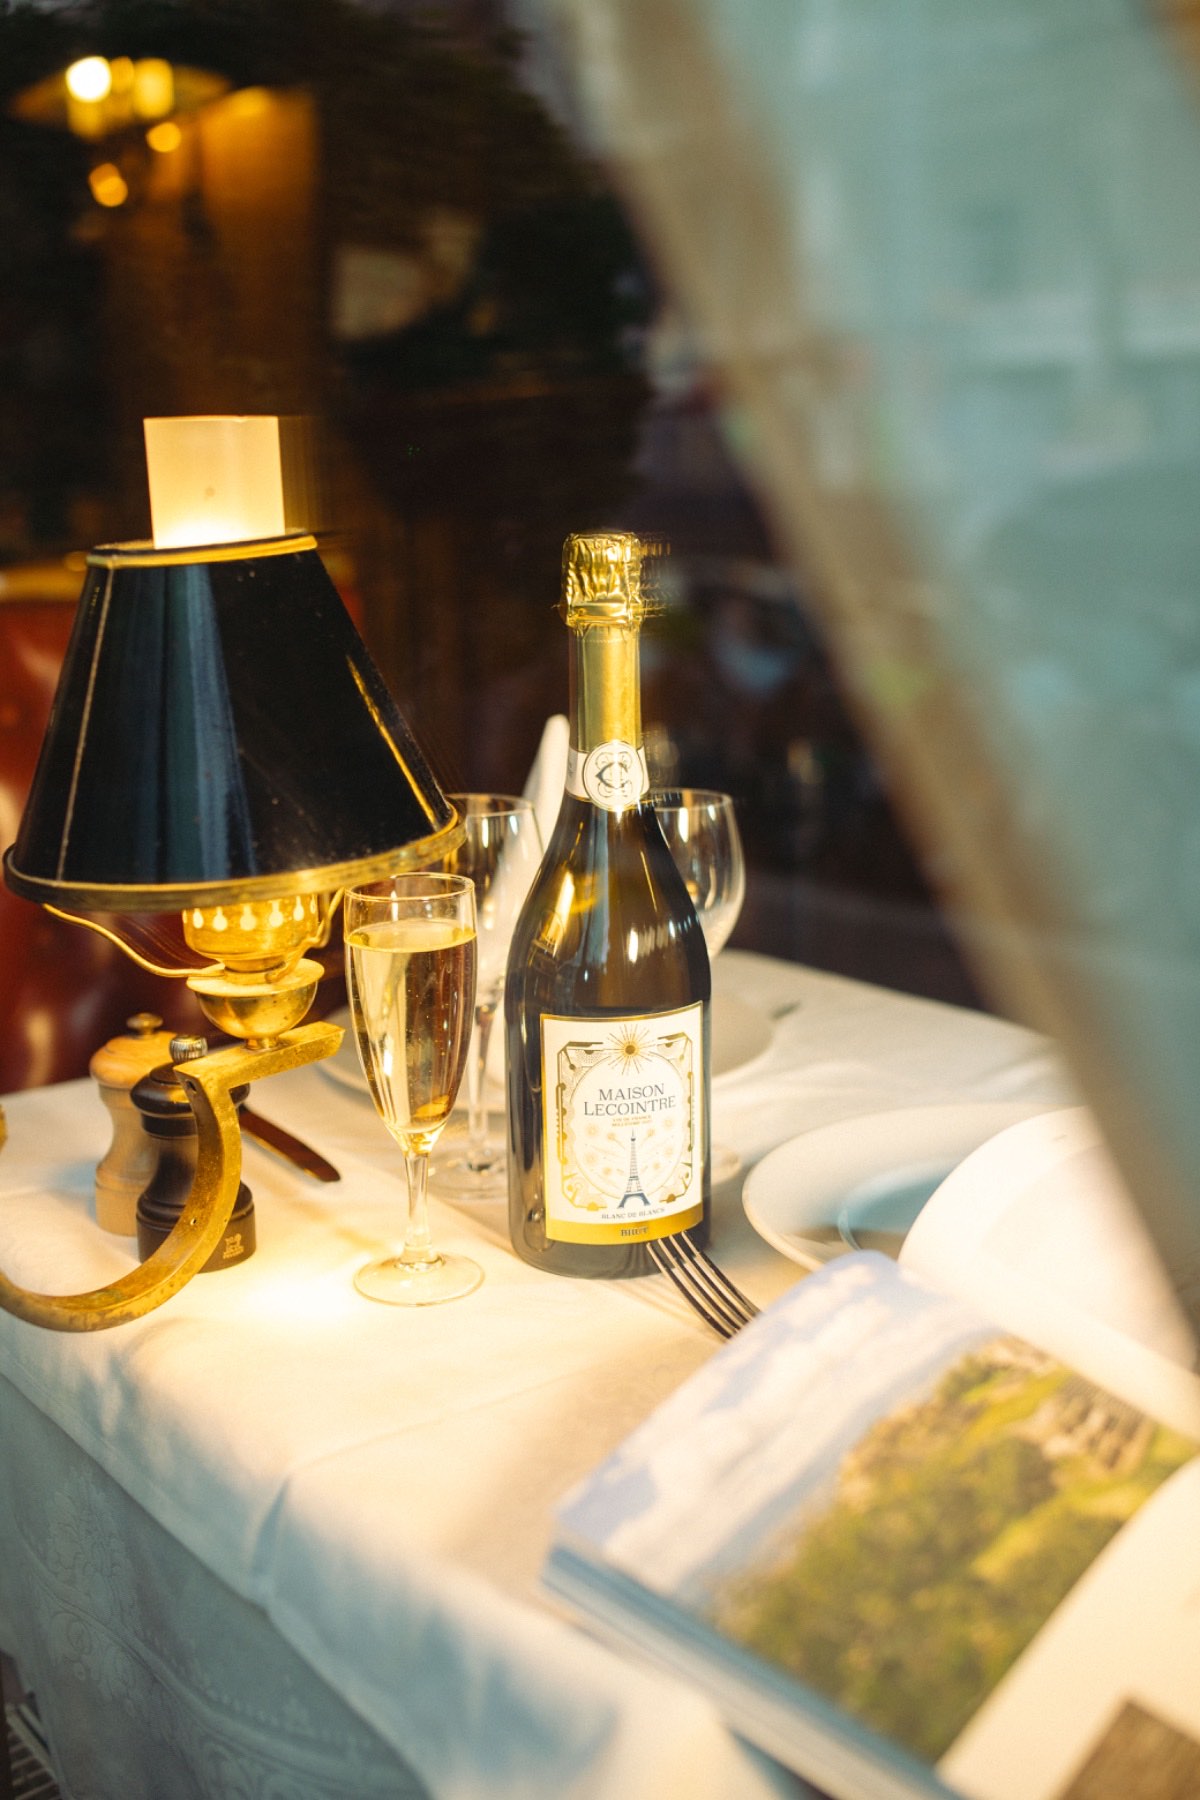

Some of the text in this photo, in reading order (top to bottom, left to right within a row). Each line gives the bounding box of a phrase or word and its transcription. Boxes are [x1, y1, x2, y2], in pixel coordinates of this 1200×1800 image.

[599, 1083, 664, 1101] MAISON
[584, 1095, 676, 1116] LECOINTRE
[638, 1207, 665, 1217] BLANCS
[620, 1226, 649, 1237] BRUT
